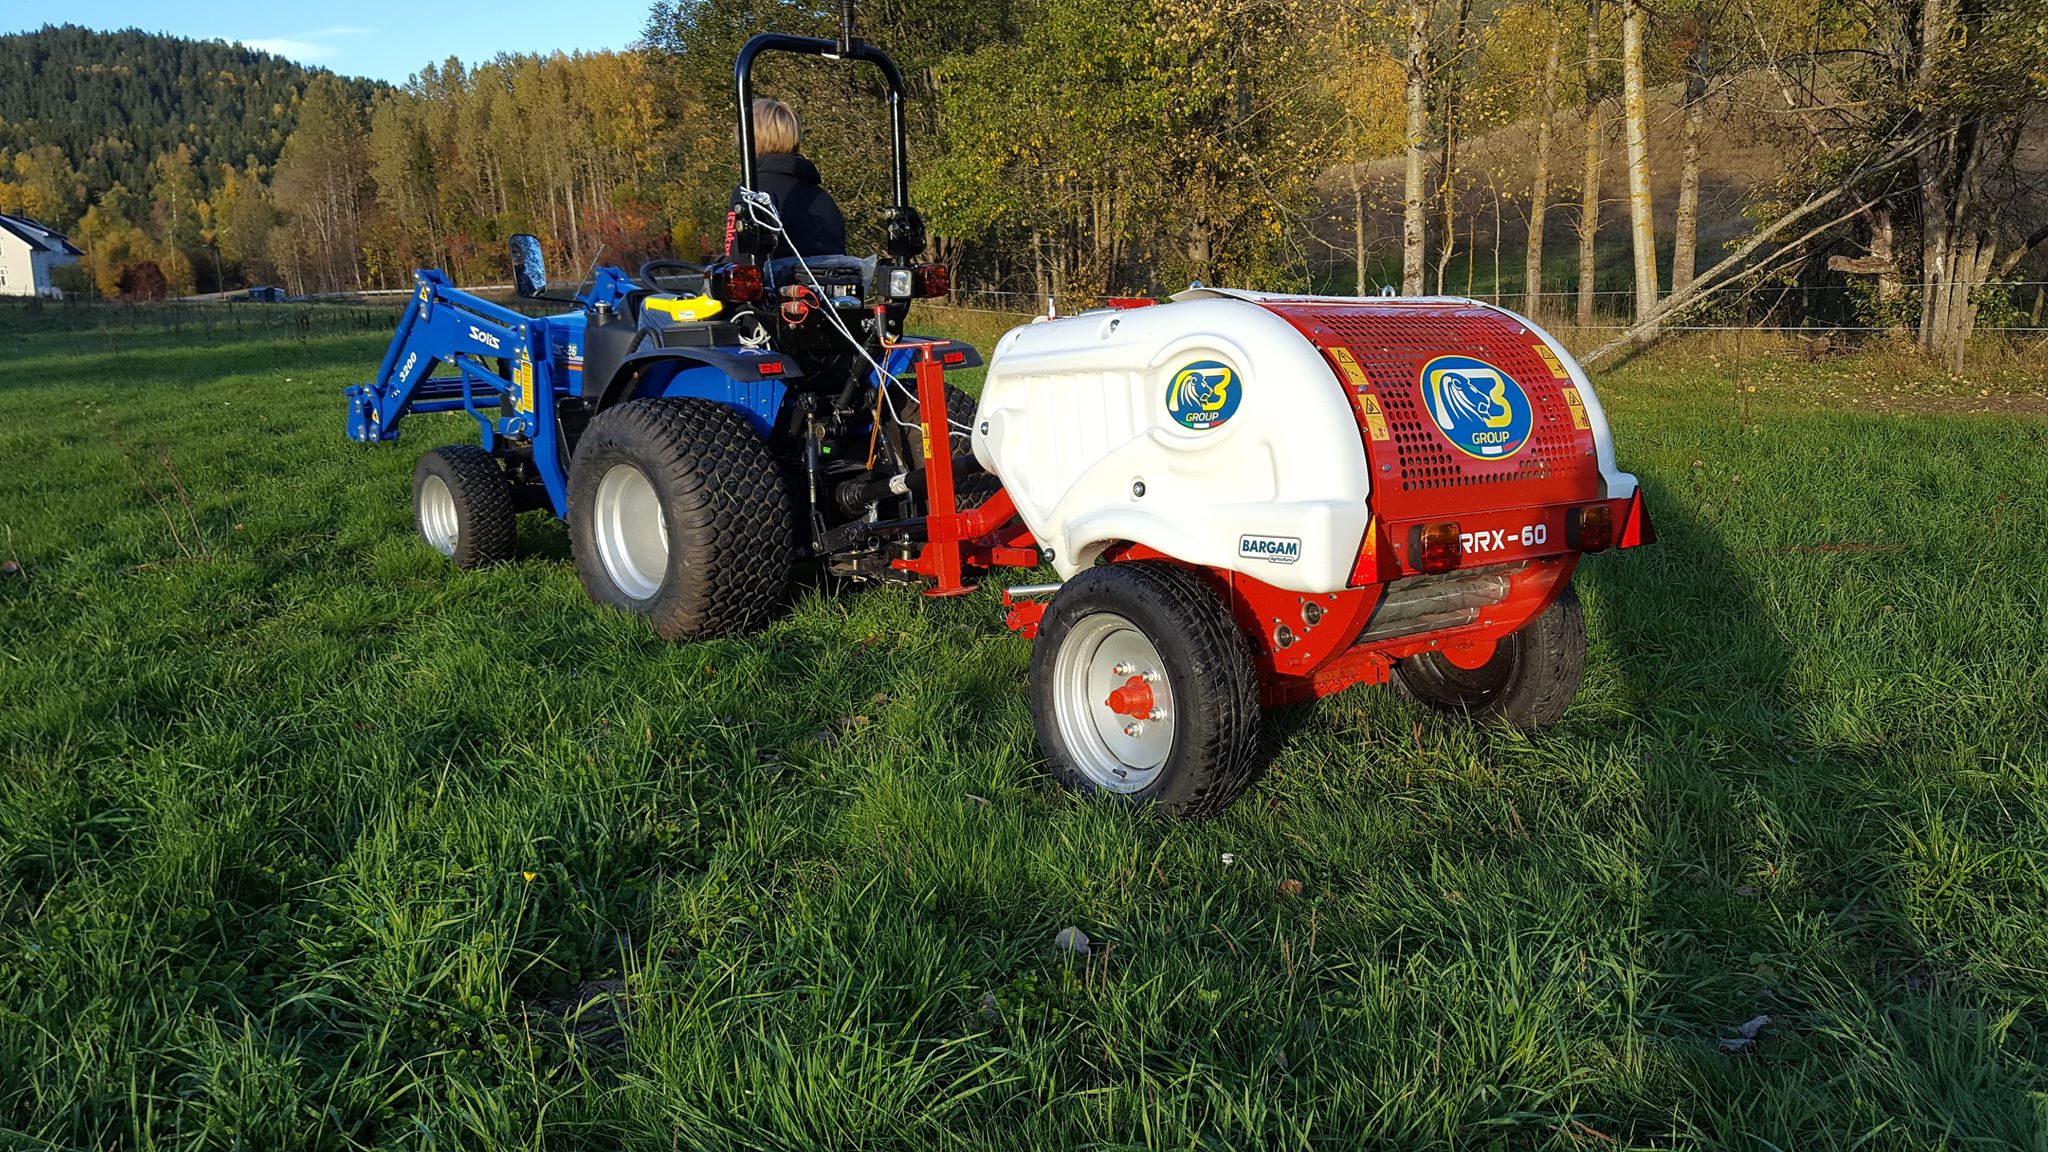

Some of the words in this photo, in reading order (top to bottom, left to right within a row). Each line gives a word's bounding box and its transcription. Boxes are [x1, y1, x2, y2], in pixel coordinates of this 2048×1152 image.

[399, 351, 417, 383] 3200
[1185, 411, 1220, 422] GROUP
[1471, 430, 1510, 445] GROUP
[1242, 539, 1297, 556] BARGAM
[1458, 523, 1547, 555] RRX-60
